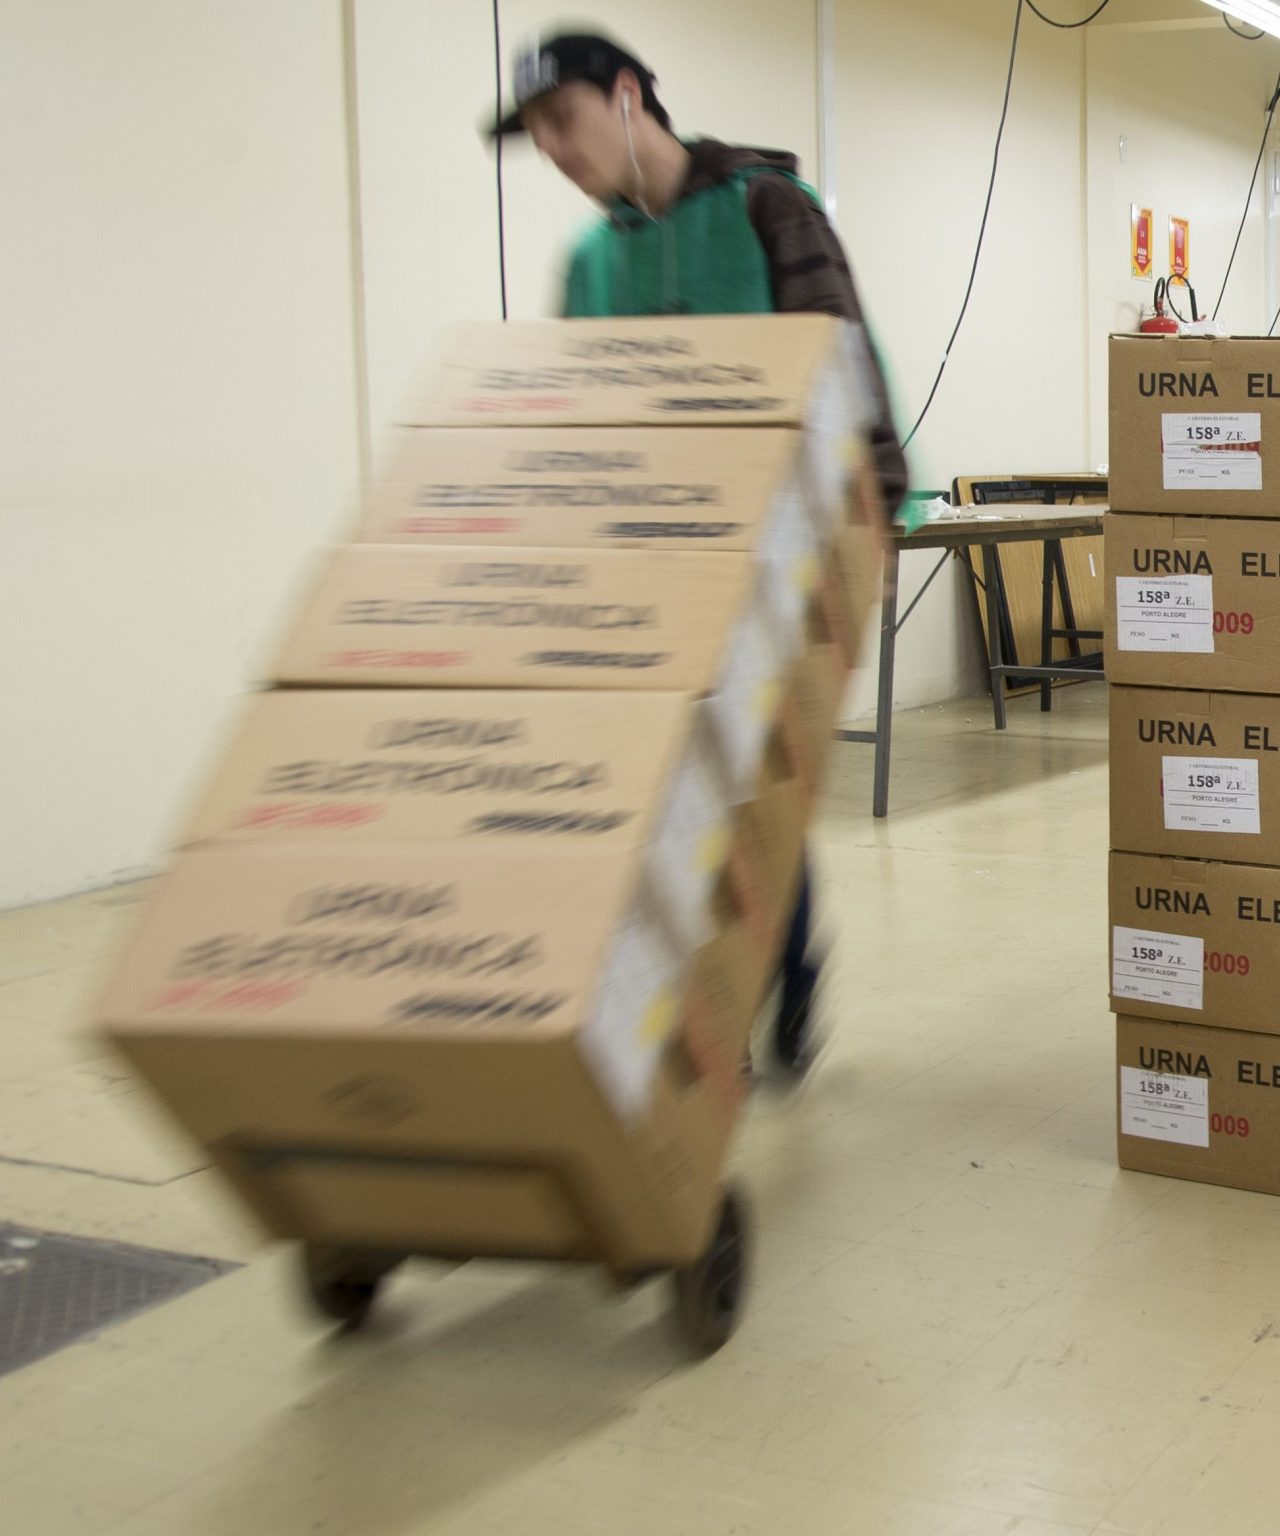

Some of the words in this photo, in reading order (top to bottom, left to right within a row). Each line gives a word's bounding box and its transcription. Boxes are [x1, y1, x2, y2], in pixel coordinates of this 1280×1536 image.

[1139, 373, 1219, 397] URNA
[1134, 549, 1213, 574] URNA
[1139, 719, 1216, 746] URNA
[1136, 887, 1211, 916] URNA
[1140, 1046, 1212, 1077] URNA
